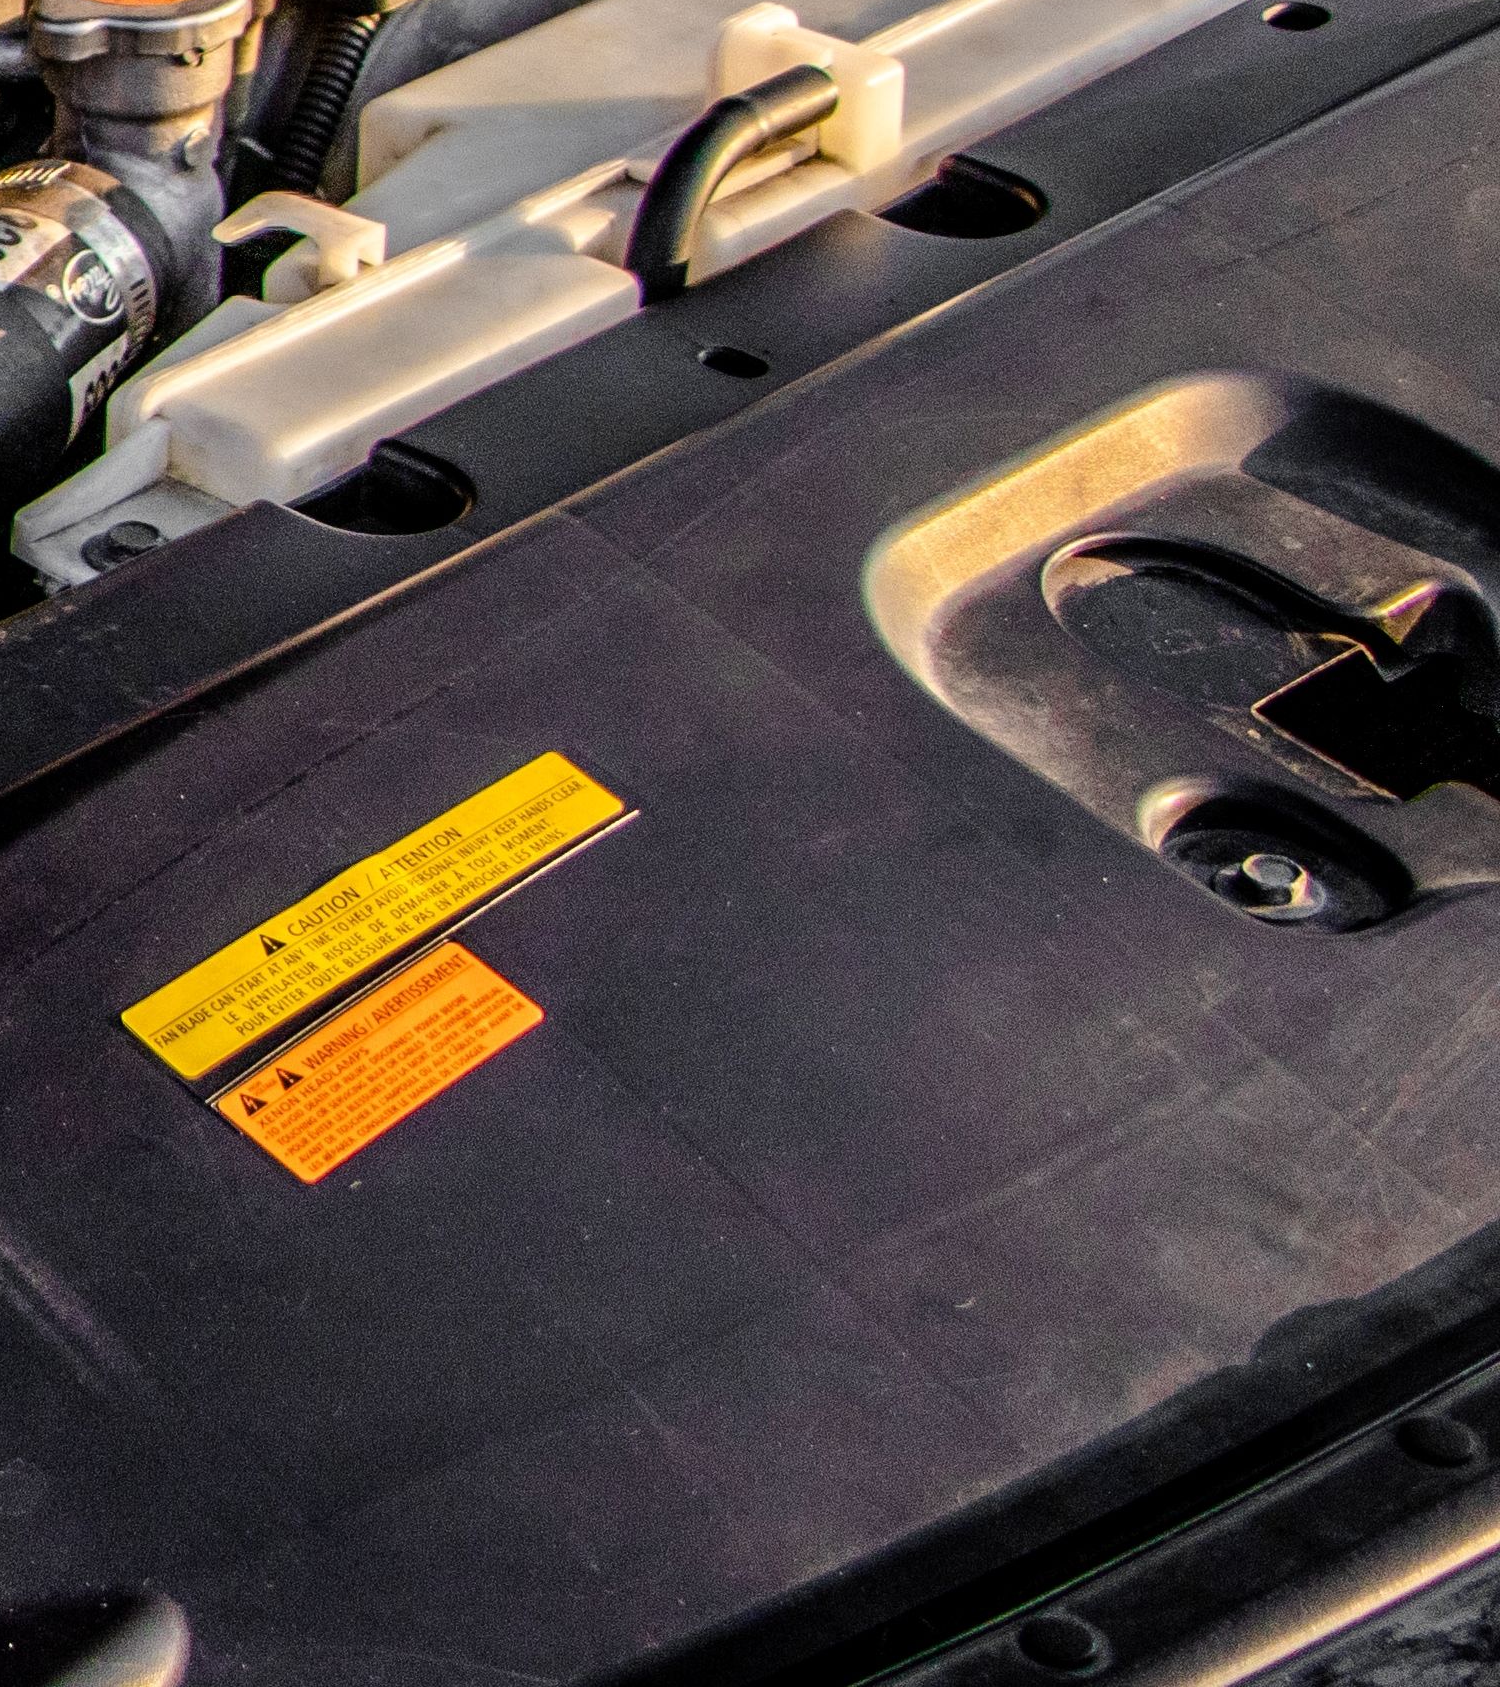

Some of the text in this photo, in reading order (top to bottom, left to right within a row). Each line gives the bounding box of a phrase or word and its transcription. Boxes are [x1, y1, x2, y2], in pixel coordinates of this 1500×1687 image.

[151, 1027, 180, 1048] FAN
[174, 1006, 214, 1034] BLADE
[207, 991, 237, 1013] CAN
[232, 971, 269, 997] START
[264, 961, 285, 977] AT
[280, 947, 307, 967] ANY
[330, 920, 351, 935] TO
[344, 903, 378, 926] HELP
[371, 882, 411, 909] AVOID
[405, 853, 460, 889] PERSONAL
[491, 816, 522, 837] KEEP
[515, 796, 555, 823] HANDS
[220, 1009, 241, 1025] LE
[240, 960, 320, 1012] VENTILATEUR
[320, 931, 368, 963] RISQUE
[366, 917, 389, 934] DE
[449, 867, 467, 881] À
[465, 849, 500, 872] TOUT
[234, 1010, 271, 1036] POUR
[264, 985, 308, 1016] ÉVITER
[304, 963, 345, 991] TOUTE
[393, 920, 415, 936] NE
[410, 906, 437, 925] PAS
[433, 896, 453, 911] EN
[447, 859, 513, 902] APPROCHER
[508, 848, 533, 865] LES
[282, 885, 363, 939] CAUTION
[375, 824, 464, 882] ATTENTION
[277, 1108, 305, 1130] AVOID
[302, 1090, 332, 1112] DEATH
[368, 1030, 416, 1066] DISCONNECT
[412, 1012, 443, 1034] POWER
[439, 993, 469, 1016] BEFORE
[299, 1021, 370, 1072] WARNING
[367, 952, 469, 1024] AVERTISSEMENT
[254, 1094, 301, 1129] XENON
[297, 1045, 371, 1098] HEADLAMPS
[276, 1115, 319, 1147] TOUCHING
